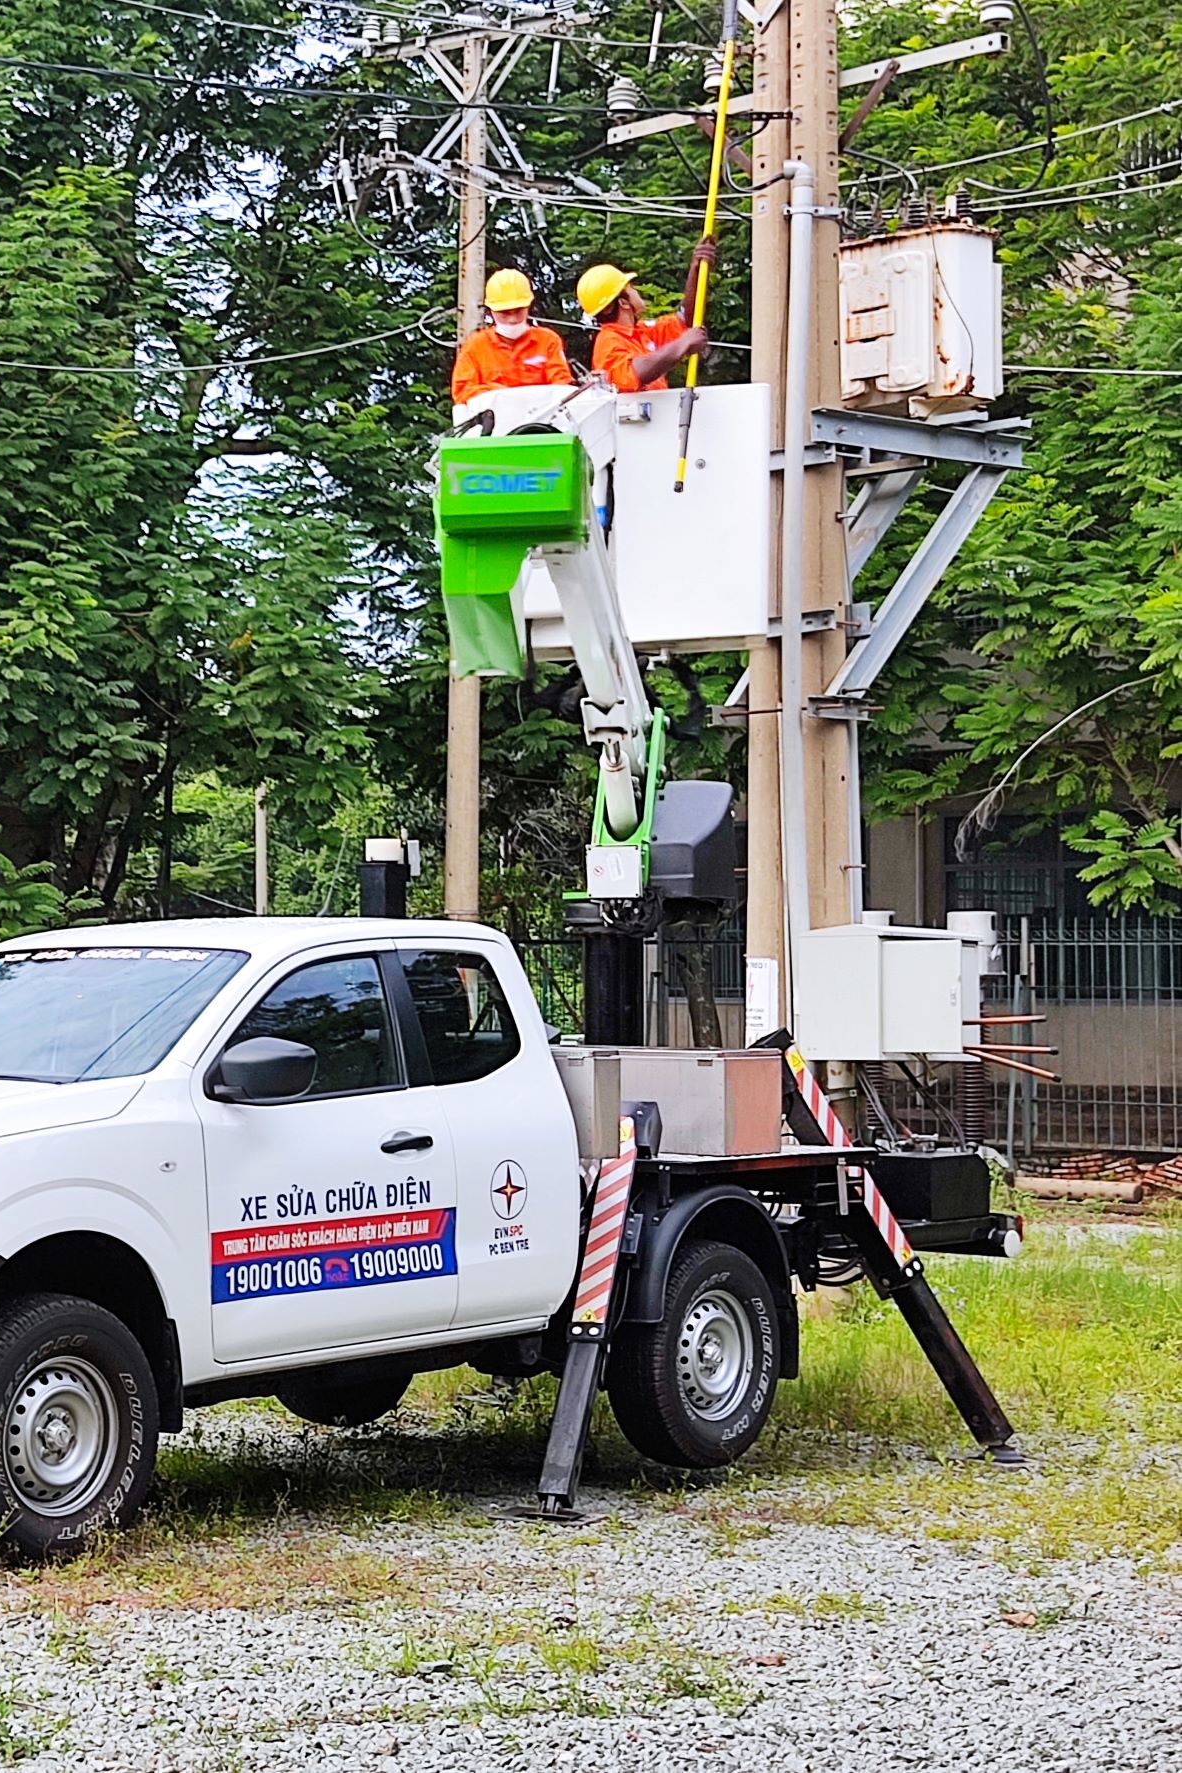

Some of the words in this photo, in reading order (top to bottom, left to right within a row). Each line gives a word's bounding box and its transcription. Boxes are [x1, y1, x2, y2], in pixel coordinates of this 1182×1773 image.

[461, 470, 562, 495] COMET
[240, 1195, 267, 1222] XE
[276, 1184, 317, 1218] SỬA
[325, 1181, 378, 1214] CHỮA
[386, 1175, 431, 1210] ĐIỆN
[225, 1257, 323, 1295] 19001006
[349, 1243, 444, 1280] 19009000
[107, 1372, 144, 1513] DUELER
